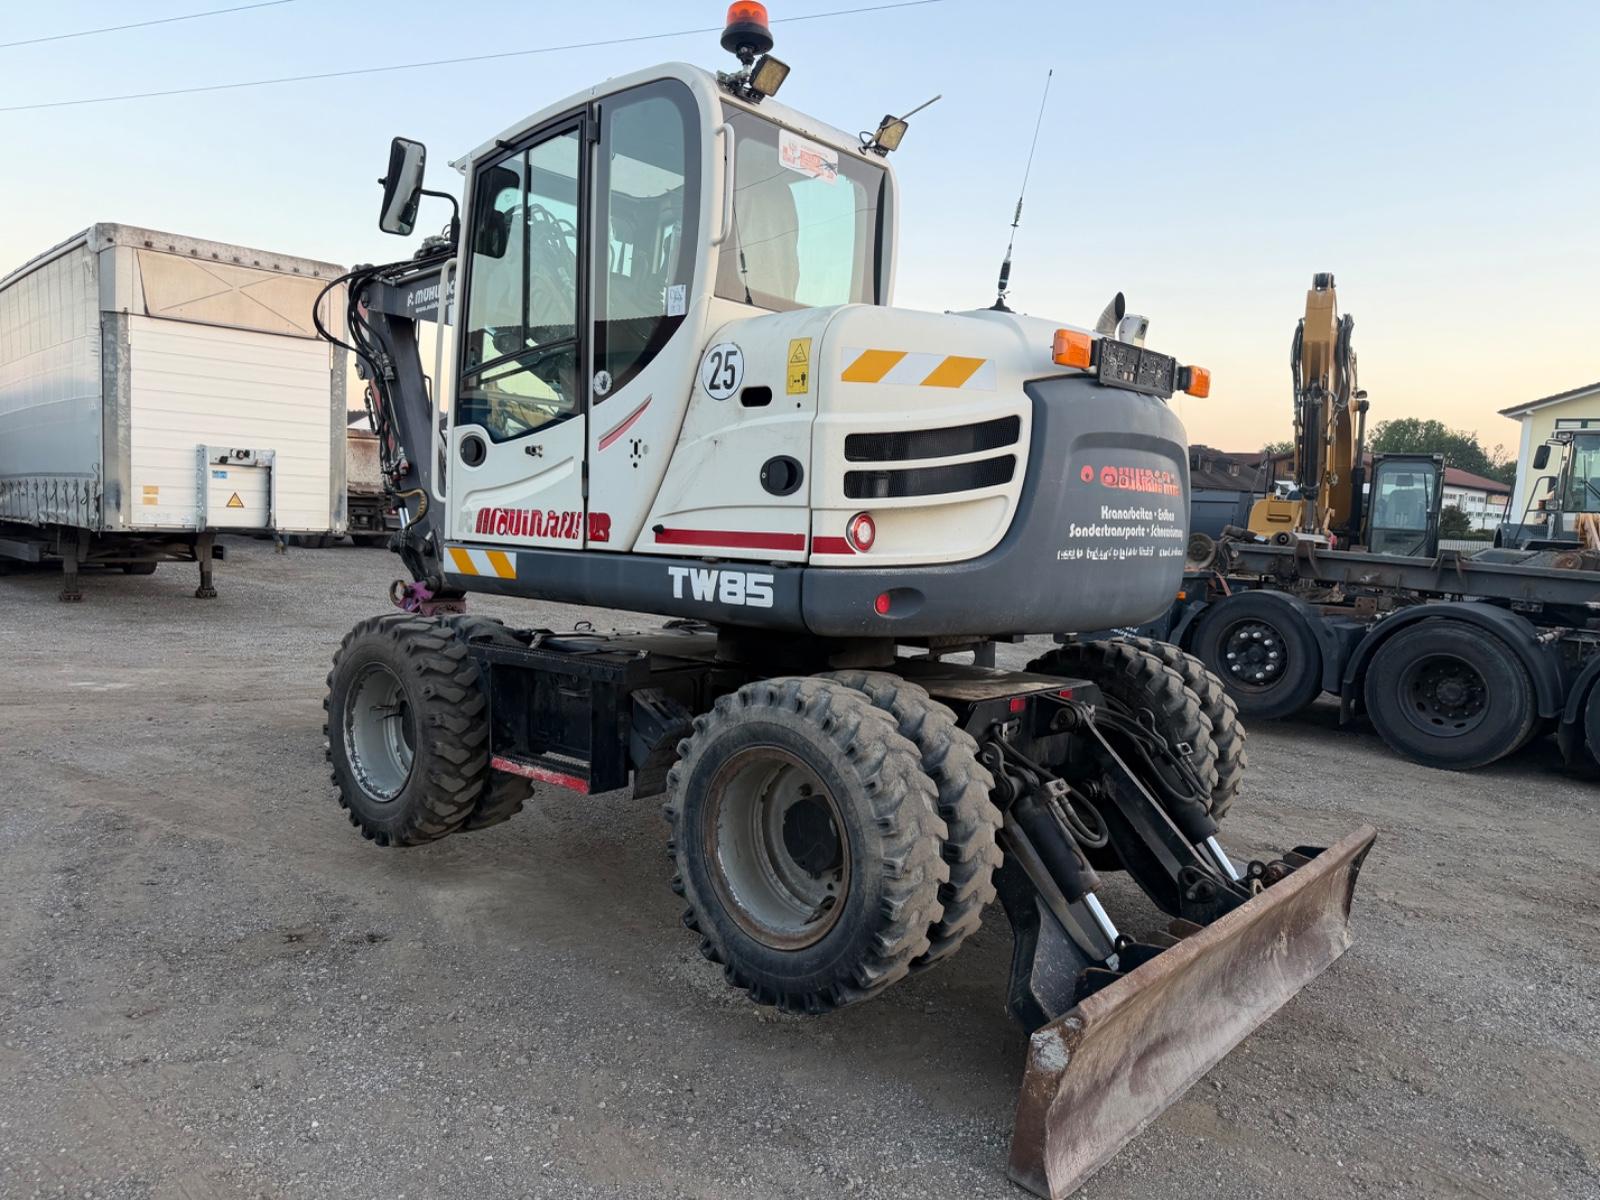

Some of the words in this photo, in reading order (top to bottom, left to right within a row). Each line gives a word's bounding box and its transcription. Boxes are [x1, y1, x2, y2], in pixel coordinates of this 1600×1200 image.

[708, 350, 738, 390] 25
[1101, 505, 1153, 520] Kranarbeiten
[1069, 523, 1145, 540] Sondertransporte
[668, 566, 774, 608] TW85
